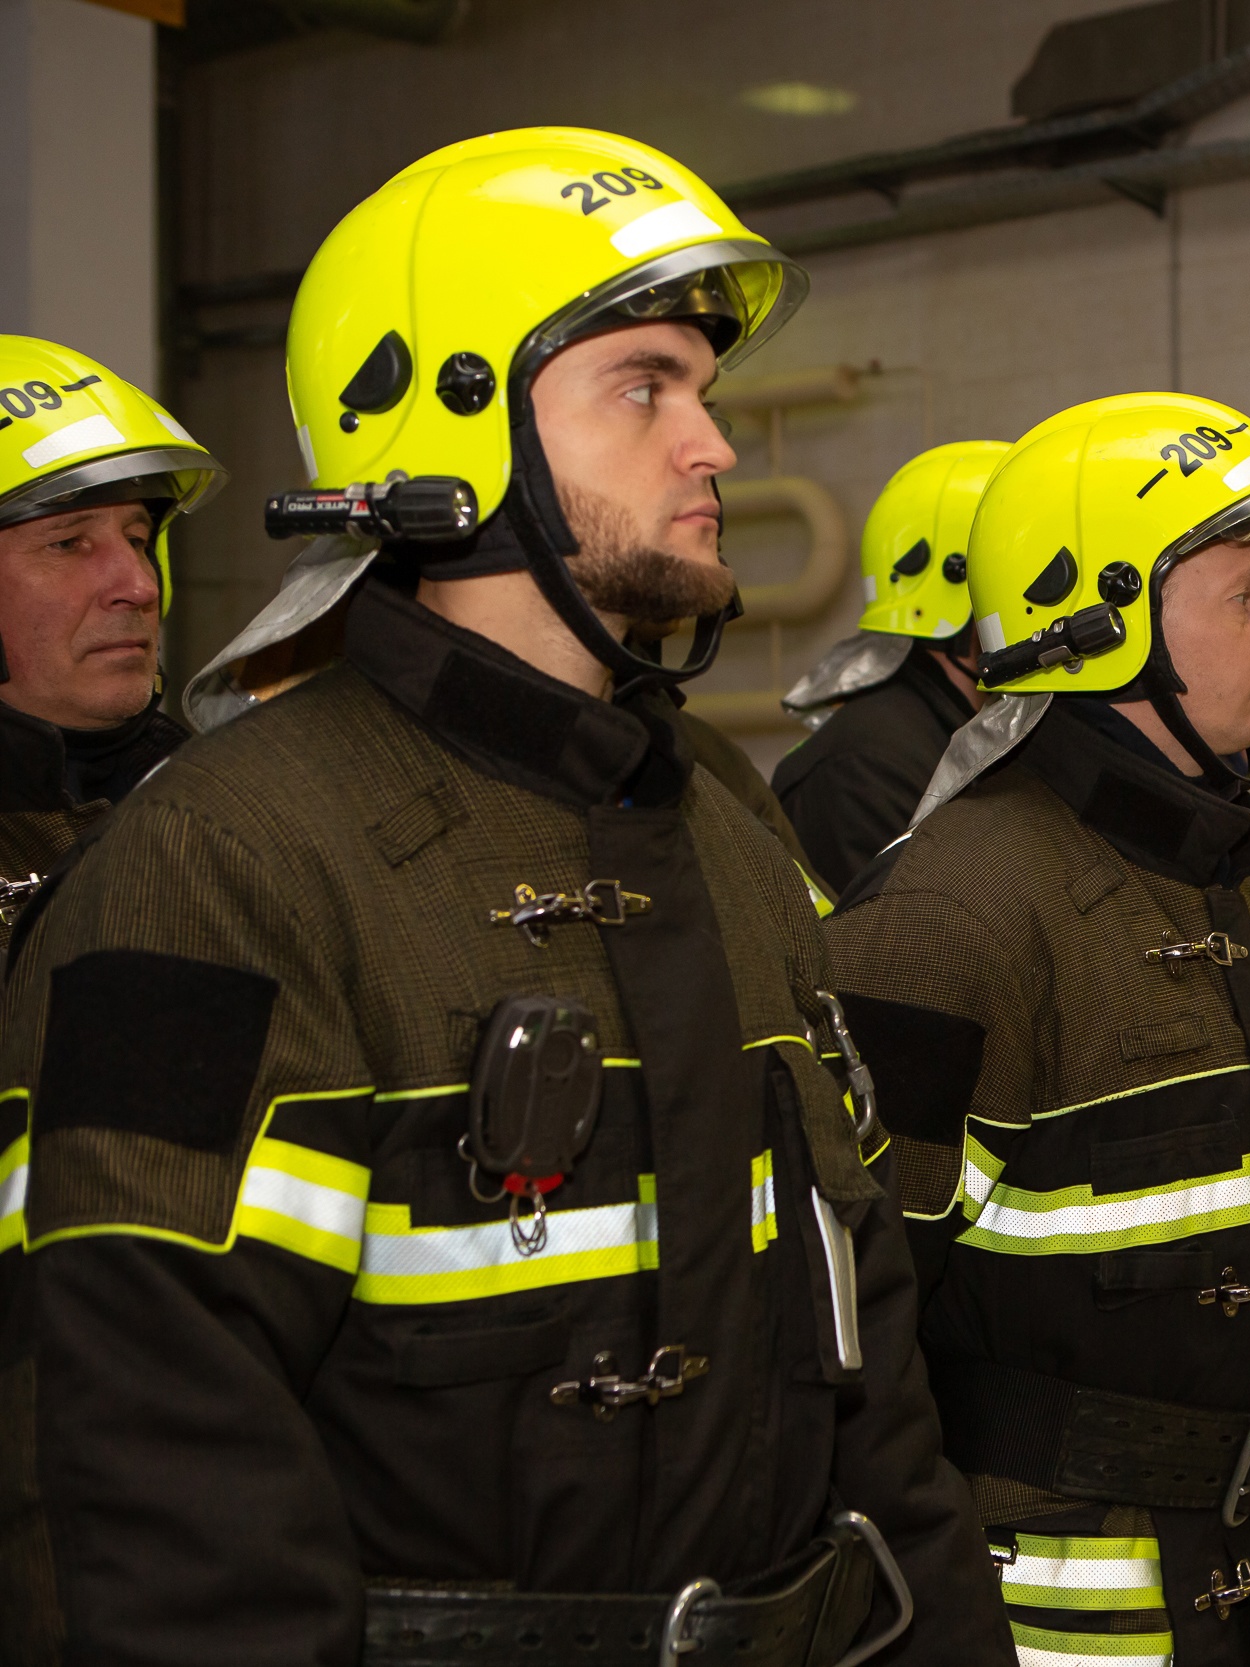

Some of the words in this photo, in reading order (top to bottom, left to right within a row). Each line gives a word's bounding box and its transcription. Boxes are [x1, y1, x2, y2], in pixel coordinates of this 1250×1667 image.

[561, 167, 663, 216] 209
[0, 381, 62, 430] 09
[1160, 426, 1233, 478] 209
[288, 502, 313, 512] PRO
